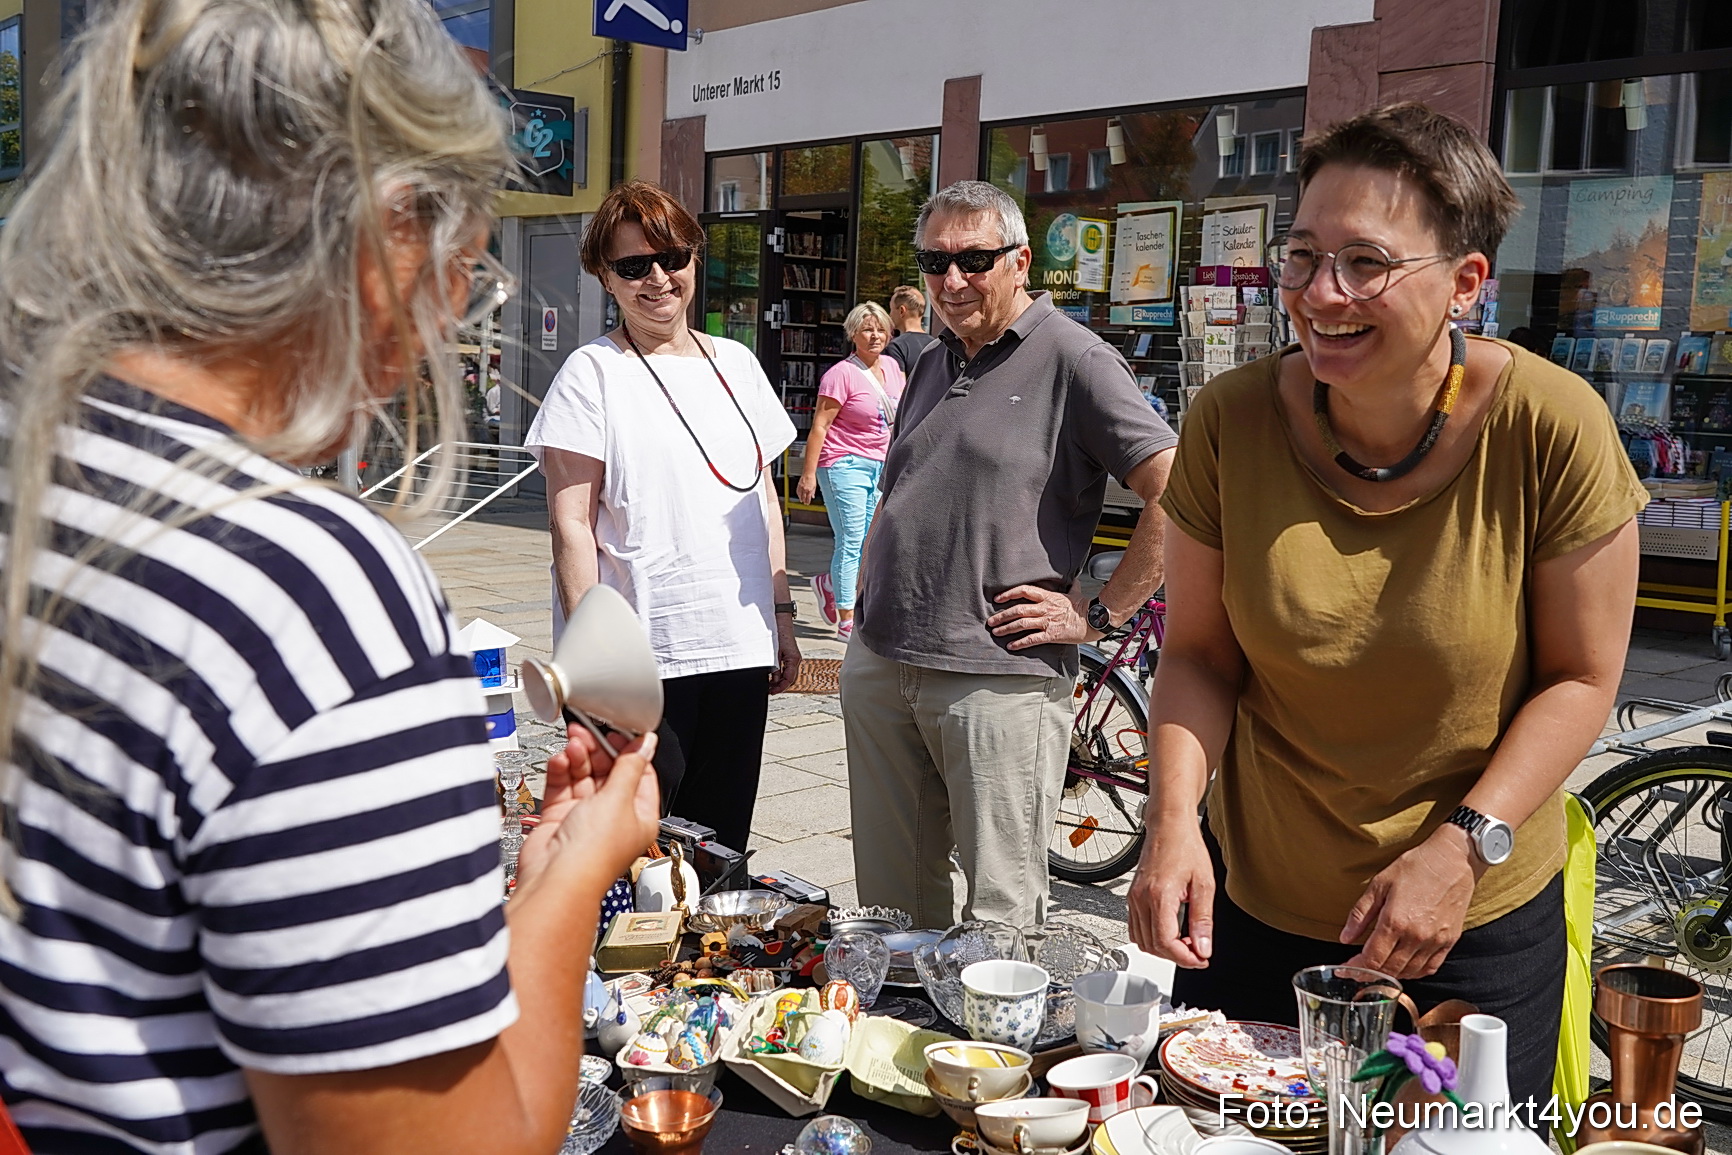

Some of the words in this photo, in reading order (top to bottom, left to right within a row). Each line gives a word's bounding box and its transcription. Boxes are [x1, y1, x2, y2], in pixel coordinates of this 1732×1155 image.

[693, 83, 731, 103] Unterer
[733, 74, 765, 97] Markt
[768, 70, 781, 91] 15
[524, 118, 554, 158] G2
[1576, 184, 1654, 207] Camping
[1135, 230, 1165, 242] Taschen-
[1222, 223, 1256, 237] Schüler-
[1135, 241, 1165, 252] kalender
[1223, 238, 1256, 251] Kalender
[1042, 270, 1082, 285] MOND
[1047, 288, 1081, 300] alender
[1143, 309, 1173, 321] Rupprecht
[1609, 310, 1659, 323] Rupprecht
